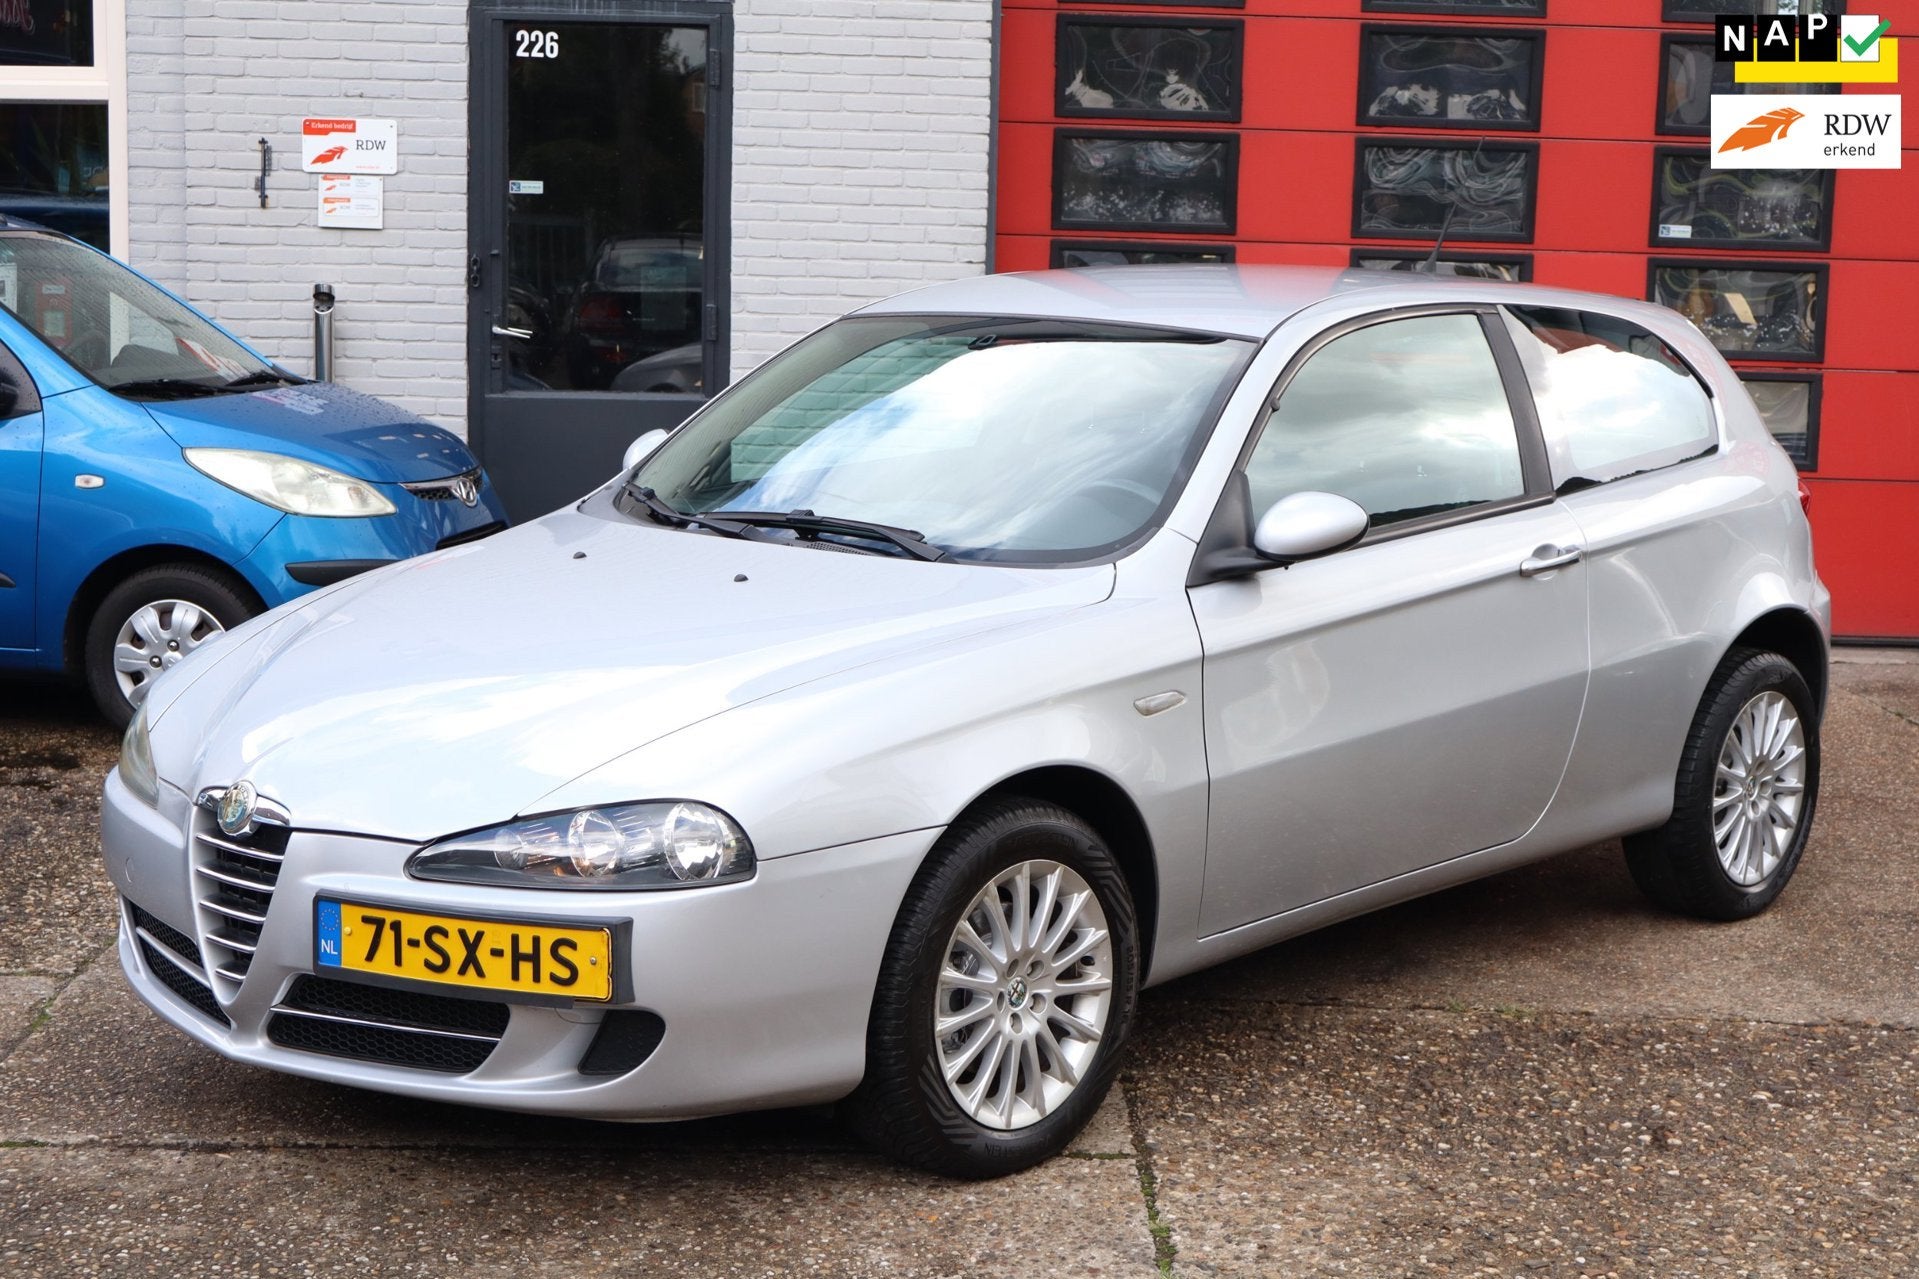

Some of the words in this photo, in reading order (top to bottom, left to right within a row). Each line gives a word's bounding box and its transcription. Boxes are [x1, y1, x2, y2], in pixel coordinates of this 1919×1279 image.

[515, 29, 559, 59] 226
[311, 121, 333, 129] Erkend
[355, 139, 386, 151] RDW
[320, 937, 339, 956] NL
[360, 914, 579, 987] 71-SX-HS
